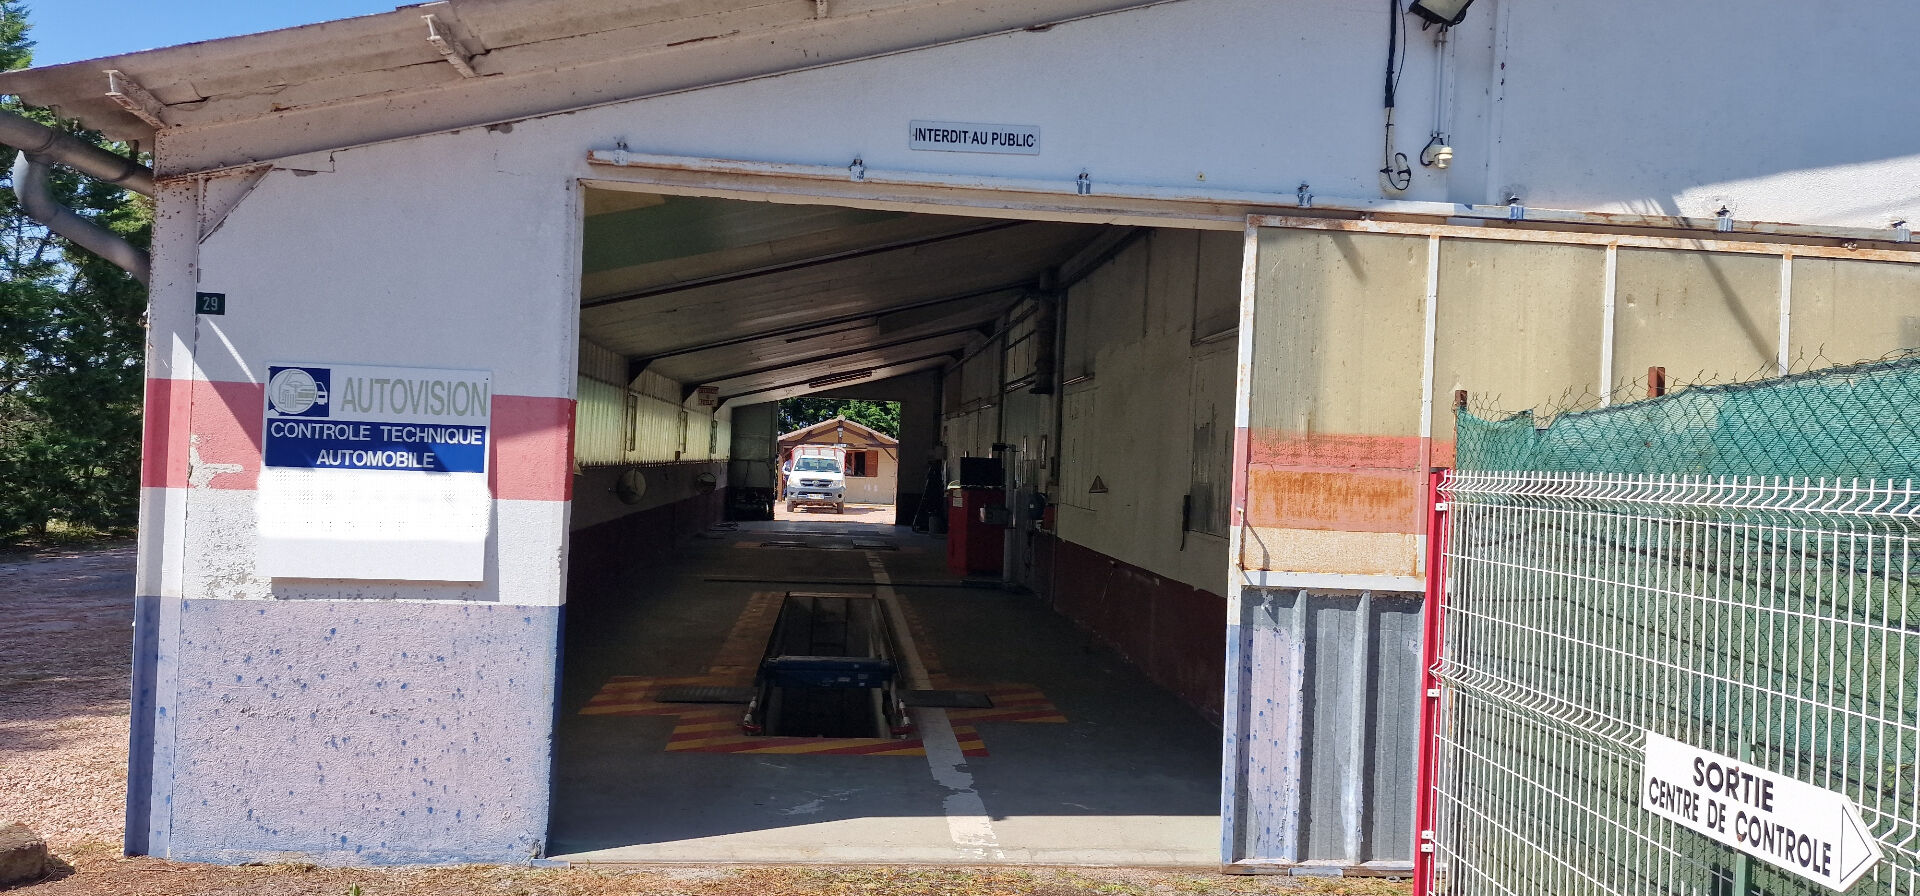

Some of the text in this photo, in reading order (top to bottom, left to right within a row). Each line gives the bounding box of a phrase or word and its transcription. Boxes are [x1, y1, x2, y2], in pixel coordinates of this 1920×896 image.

[915, 127, 1034, 148] INTERDIT AU PUBLIC
[203, 296, 218, 311] 29
[340, 377, 488, 417] AUTOVISION
[271, 422, 482, 445] CONTROLE TECHNIQUE
[316, 449, 435, 468] AUTOMOBILE
[1692, 756, 1774, 813] SORTIE
[1648, 777, 1831, 877] CENTRE DE CONTROLE
